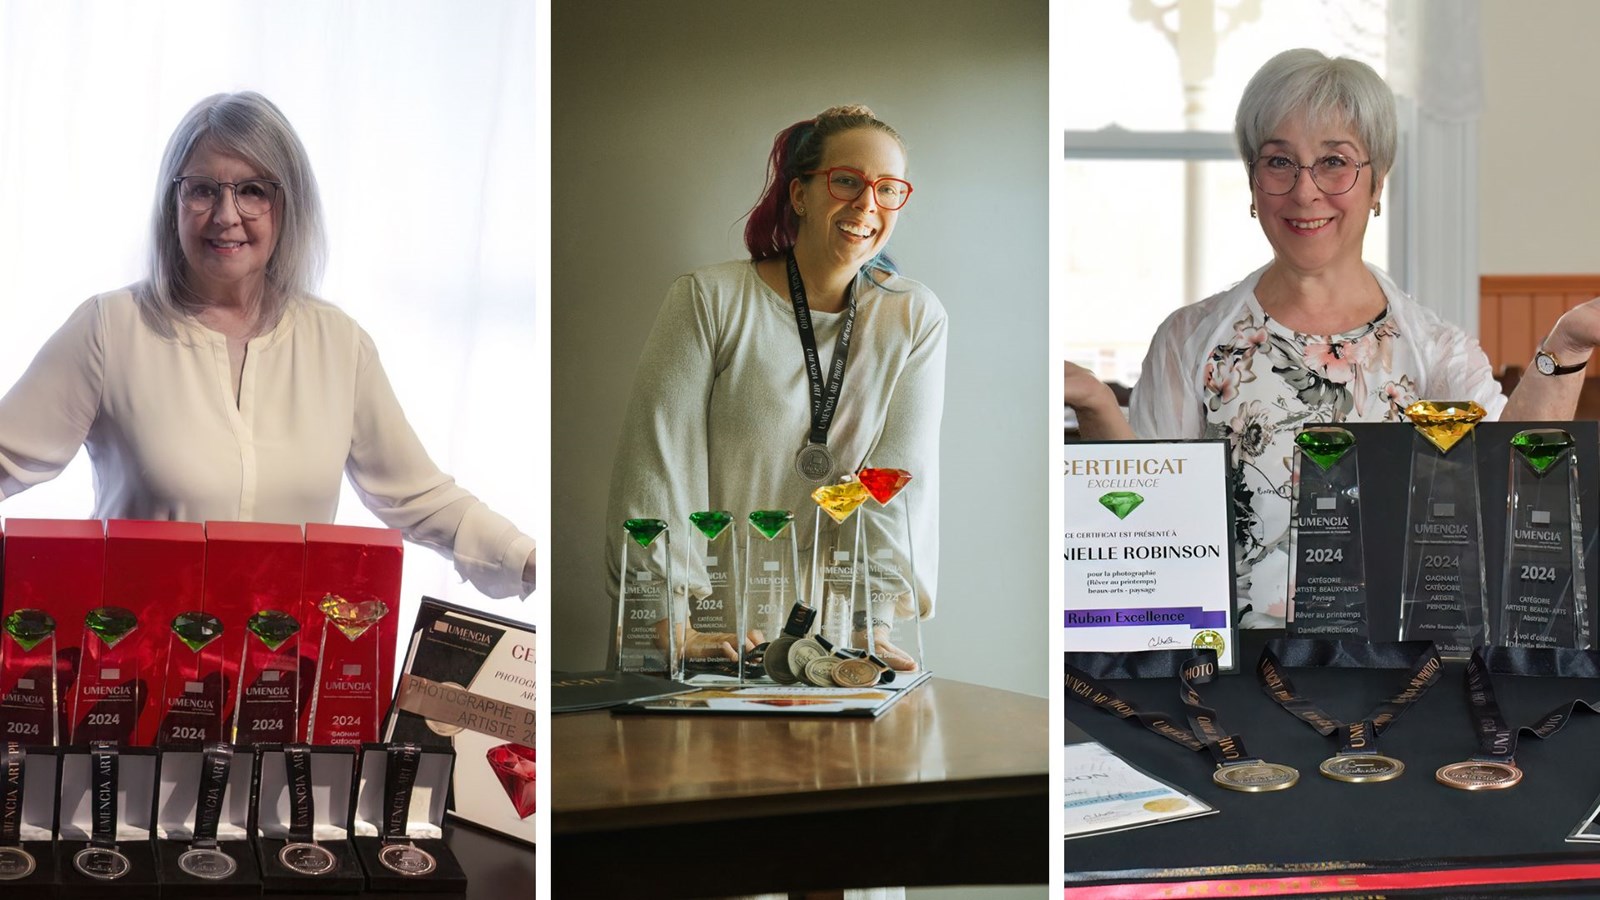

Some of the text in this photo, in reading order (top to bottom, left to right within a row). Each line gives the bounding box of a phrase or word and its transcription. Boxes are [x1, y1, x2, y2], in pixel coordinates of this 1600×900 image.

[818, 359, 844, 429] UMENCIA ART PHOTO
[1088, 479, 1160, 489] EXCELLENCE
[1299, 517, 1349, 527] UMENCIA
[1134, 530, 1171, 538] PRÉSENTÉ
[1415, 524, 1468, 535] UMENCIA
[1515, 530, 1561, 541] UMENCIA
[1124, 544, 1220, 560] ROBINSON
[1305, 548, 1344, 563] 2024
[1425, 555, 1460, 568] 2024
[1112, 570, 1157, 579] photographie
[1520, 565, 1556, 581] 2024
[1308, 576, 1342, 584] CATÉGORIE
[1129, 587, 1156, 595] paysage
[1425, 583, 1461, 592] CATÉGORIE
[871, 592, 899, 603] 2024
[1312, 595, 1336, 603] Paysage
[1519, 596, 1551, 605] CATÉGORIE
[696, 599, 724, 610] 2024
[1505, 604, 1528, 612] ARTISTE
[630, 609, 657, 620] 2024
[1068, 610, 1185, 624] Ruban Excellence
[1295, 611, 1315, 619] Rêver
[1326, 611, 1361, 620] printemps
[447, 626, 493, 645] UMENCIA
[1326, 625, 1359, 634] Robinson
[512, 644, 536, 665] CE
[84, 686, 131, 696] UMENCIA
[246, 687, 290, 697] UMENCIA
[326, 682, 372, 692] UMENCIA
[1, 693, 45, 705] UMENCIA
[168, 697, 214, 709] UMENCIA
[409, 679, 536, 727] PHOTOGRAPHE D
[88, 713, 121, 726] 2024
[252, 719, 284, 732] 2024
[332, 715, 361, 727] 2024
[457, 711, 517, 739] ARTISTE
[7, 721, 40, 736] 2024
[171, 726, 206, 741] 2024
[100, 753, 112, 776] ART
[213, 758, 226, 776] ART
[8, 760, 20, 784] ART
[295, 774, 309, 828] UMENCIA
[100, 781, 112, 834] UMENCIA
